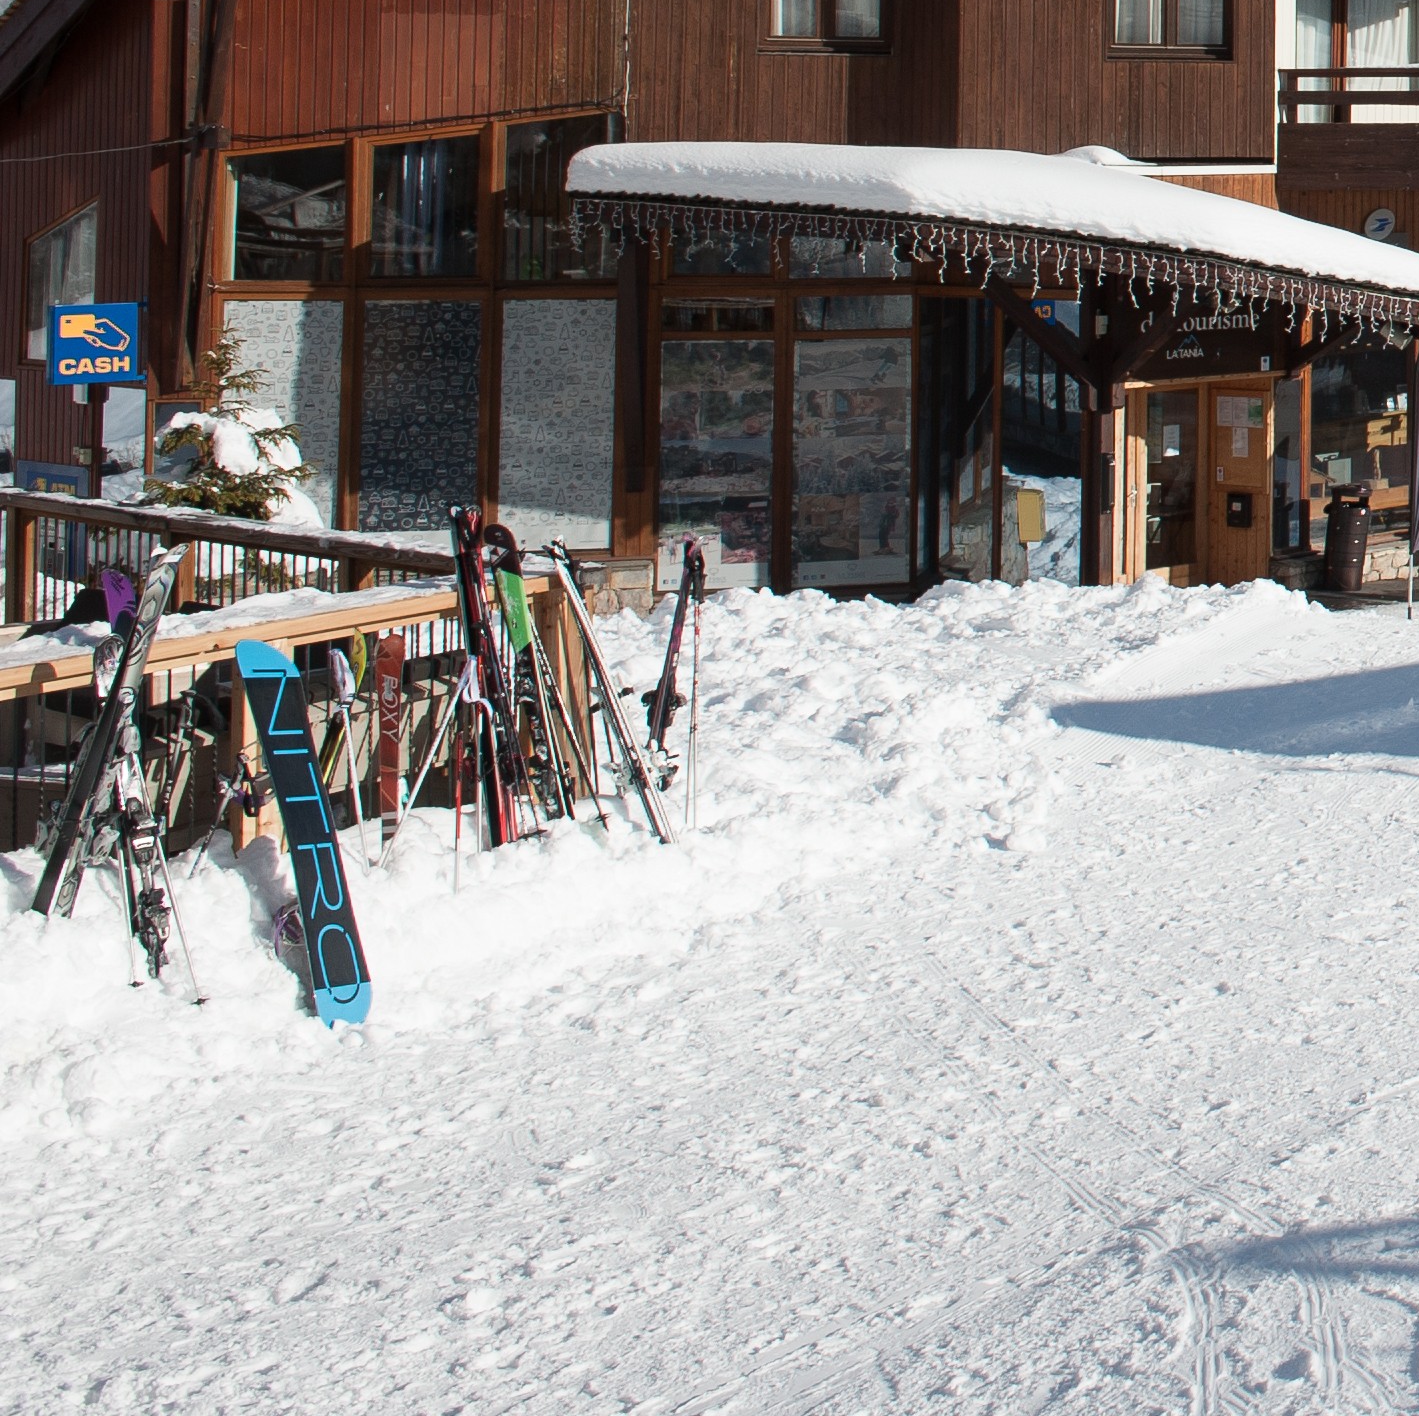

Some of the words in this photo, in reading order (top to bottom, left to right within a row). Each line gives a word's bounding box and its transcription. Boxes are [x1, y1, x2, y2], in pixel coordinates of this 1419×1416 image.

[1176, 312, 1260, 333] ourisme
[1178, 347, 1204, 358] TANIA
[58, 356, 130, 375] CASH
[250, 668, 362, 1005] NITRO
